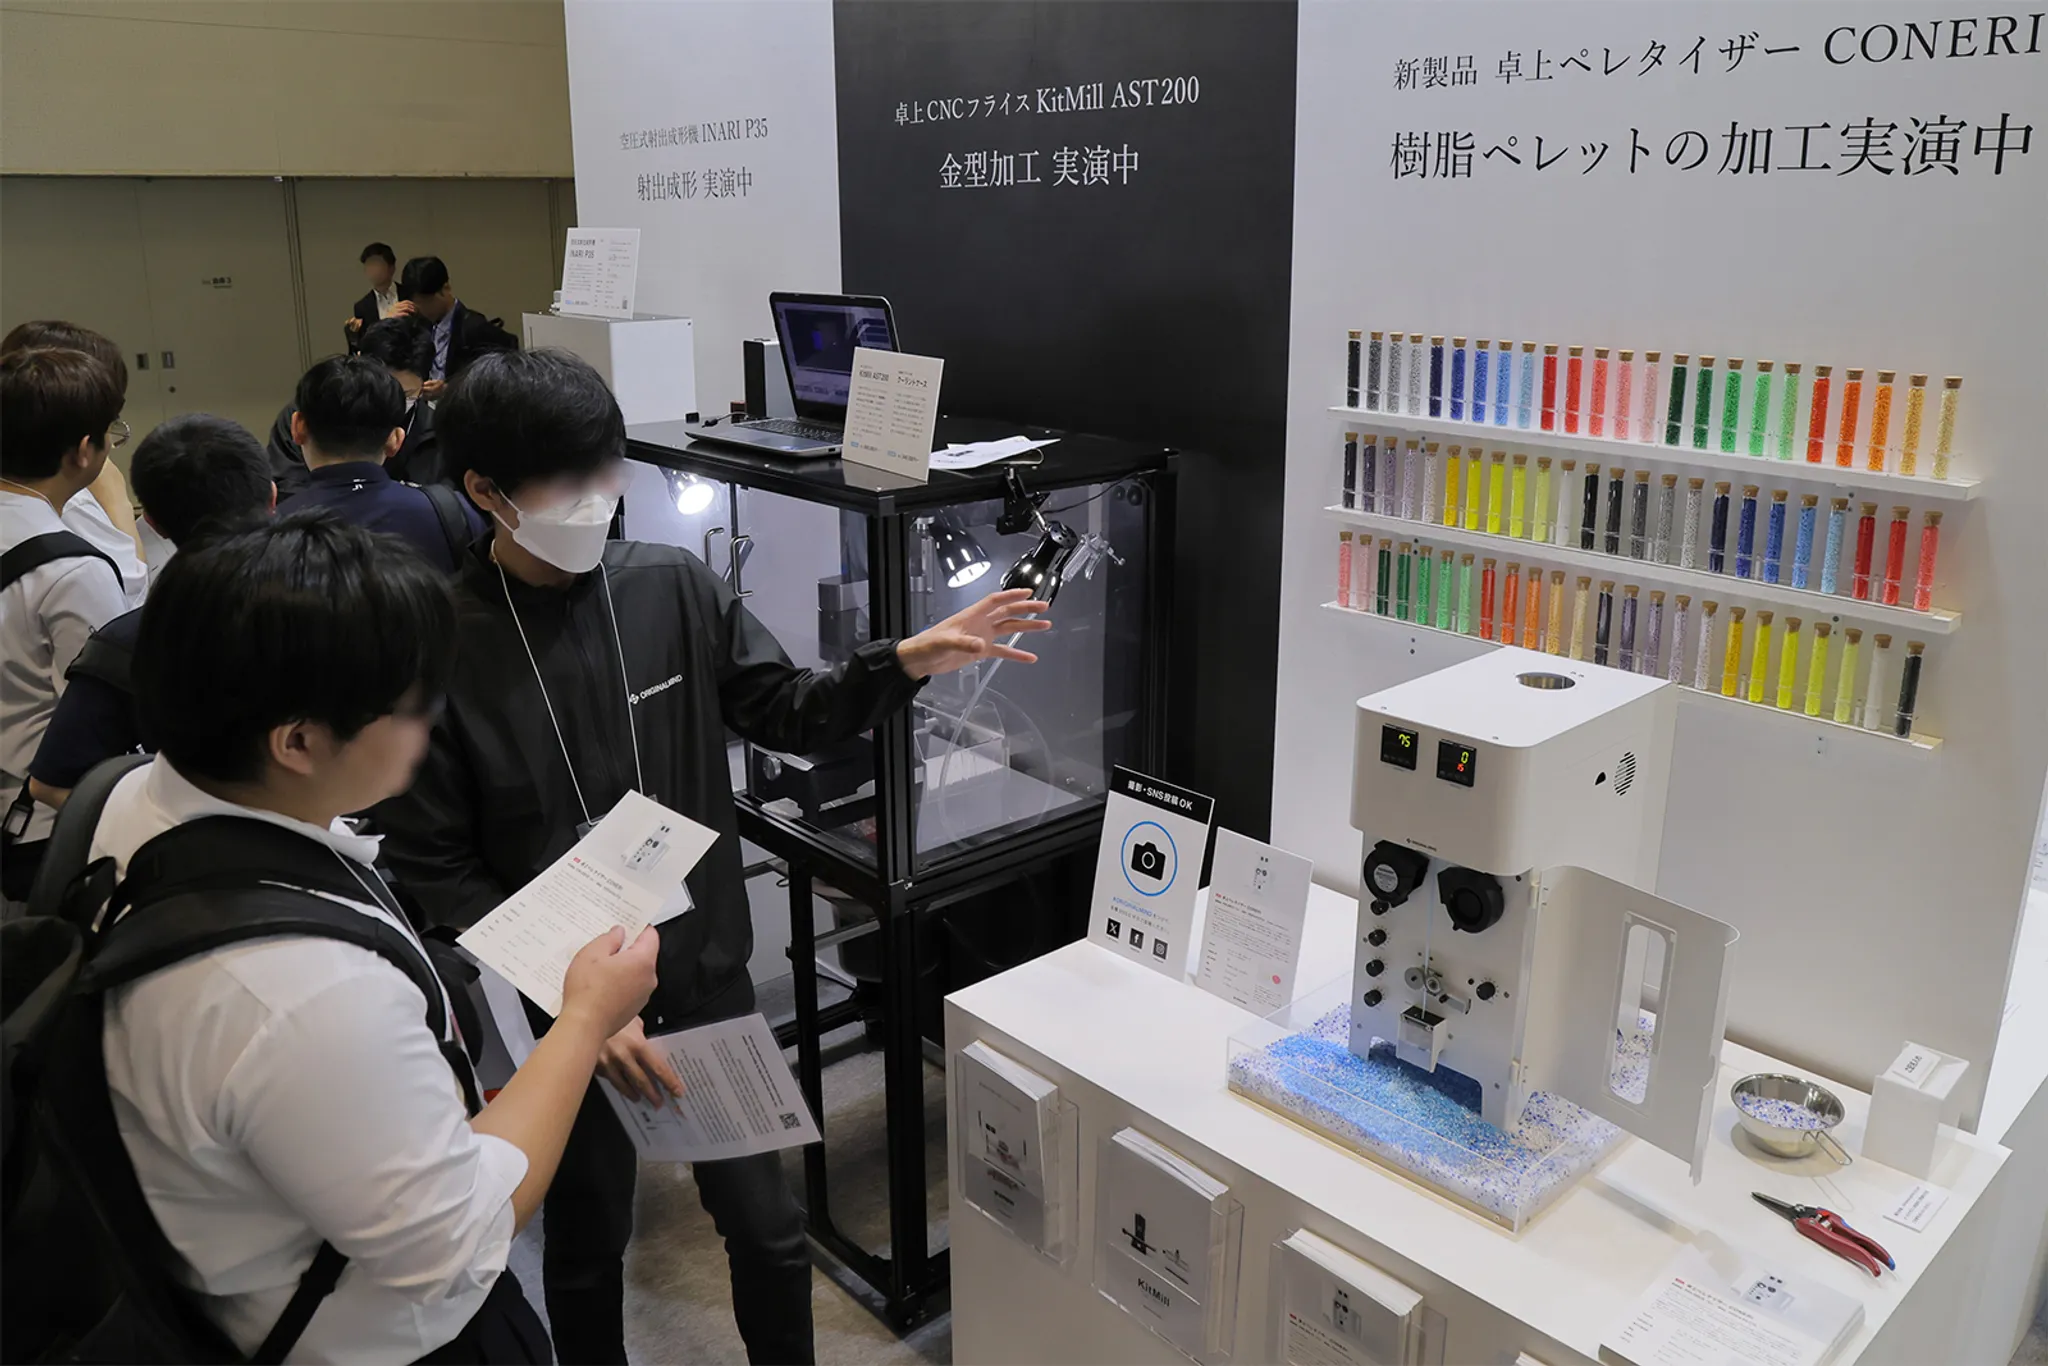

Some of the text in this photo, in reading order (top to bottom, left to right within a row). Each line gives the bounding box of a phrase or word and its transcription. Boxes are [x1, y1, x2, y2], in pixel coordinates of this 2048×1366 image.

[1393, 12, 2046, 91] 新製品 卓上ペレタイザー CONERI
[1035, 82, 1105, 114] KitMill
[1111, 75, 1200, 109] AST200
[702, 119, 741, 143] INARI
[745, 117, 768, 140] P35
[1389, 112, 2034, 180] 樹脂ペレットの加工実演中
[637, 166, 753, 202] 射出成形 実演中
[938, 143, 1139, 189] 金型加工 実演中
[1398, 733, 1411, 748] 75
[1137, 1277, 1170, 1307] KitMill
